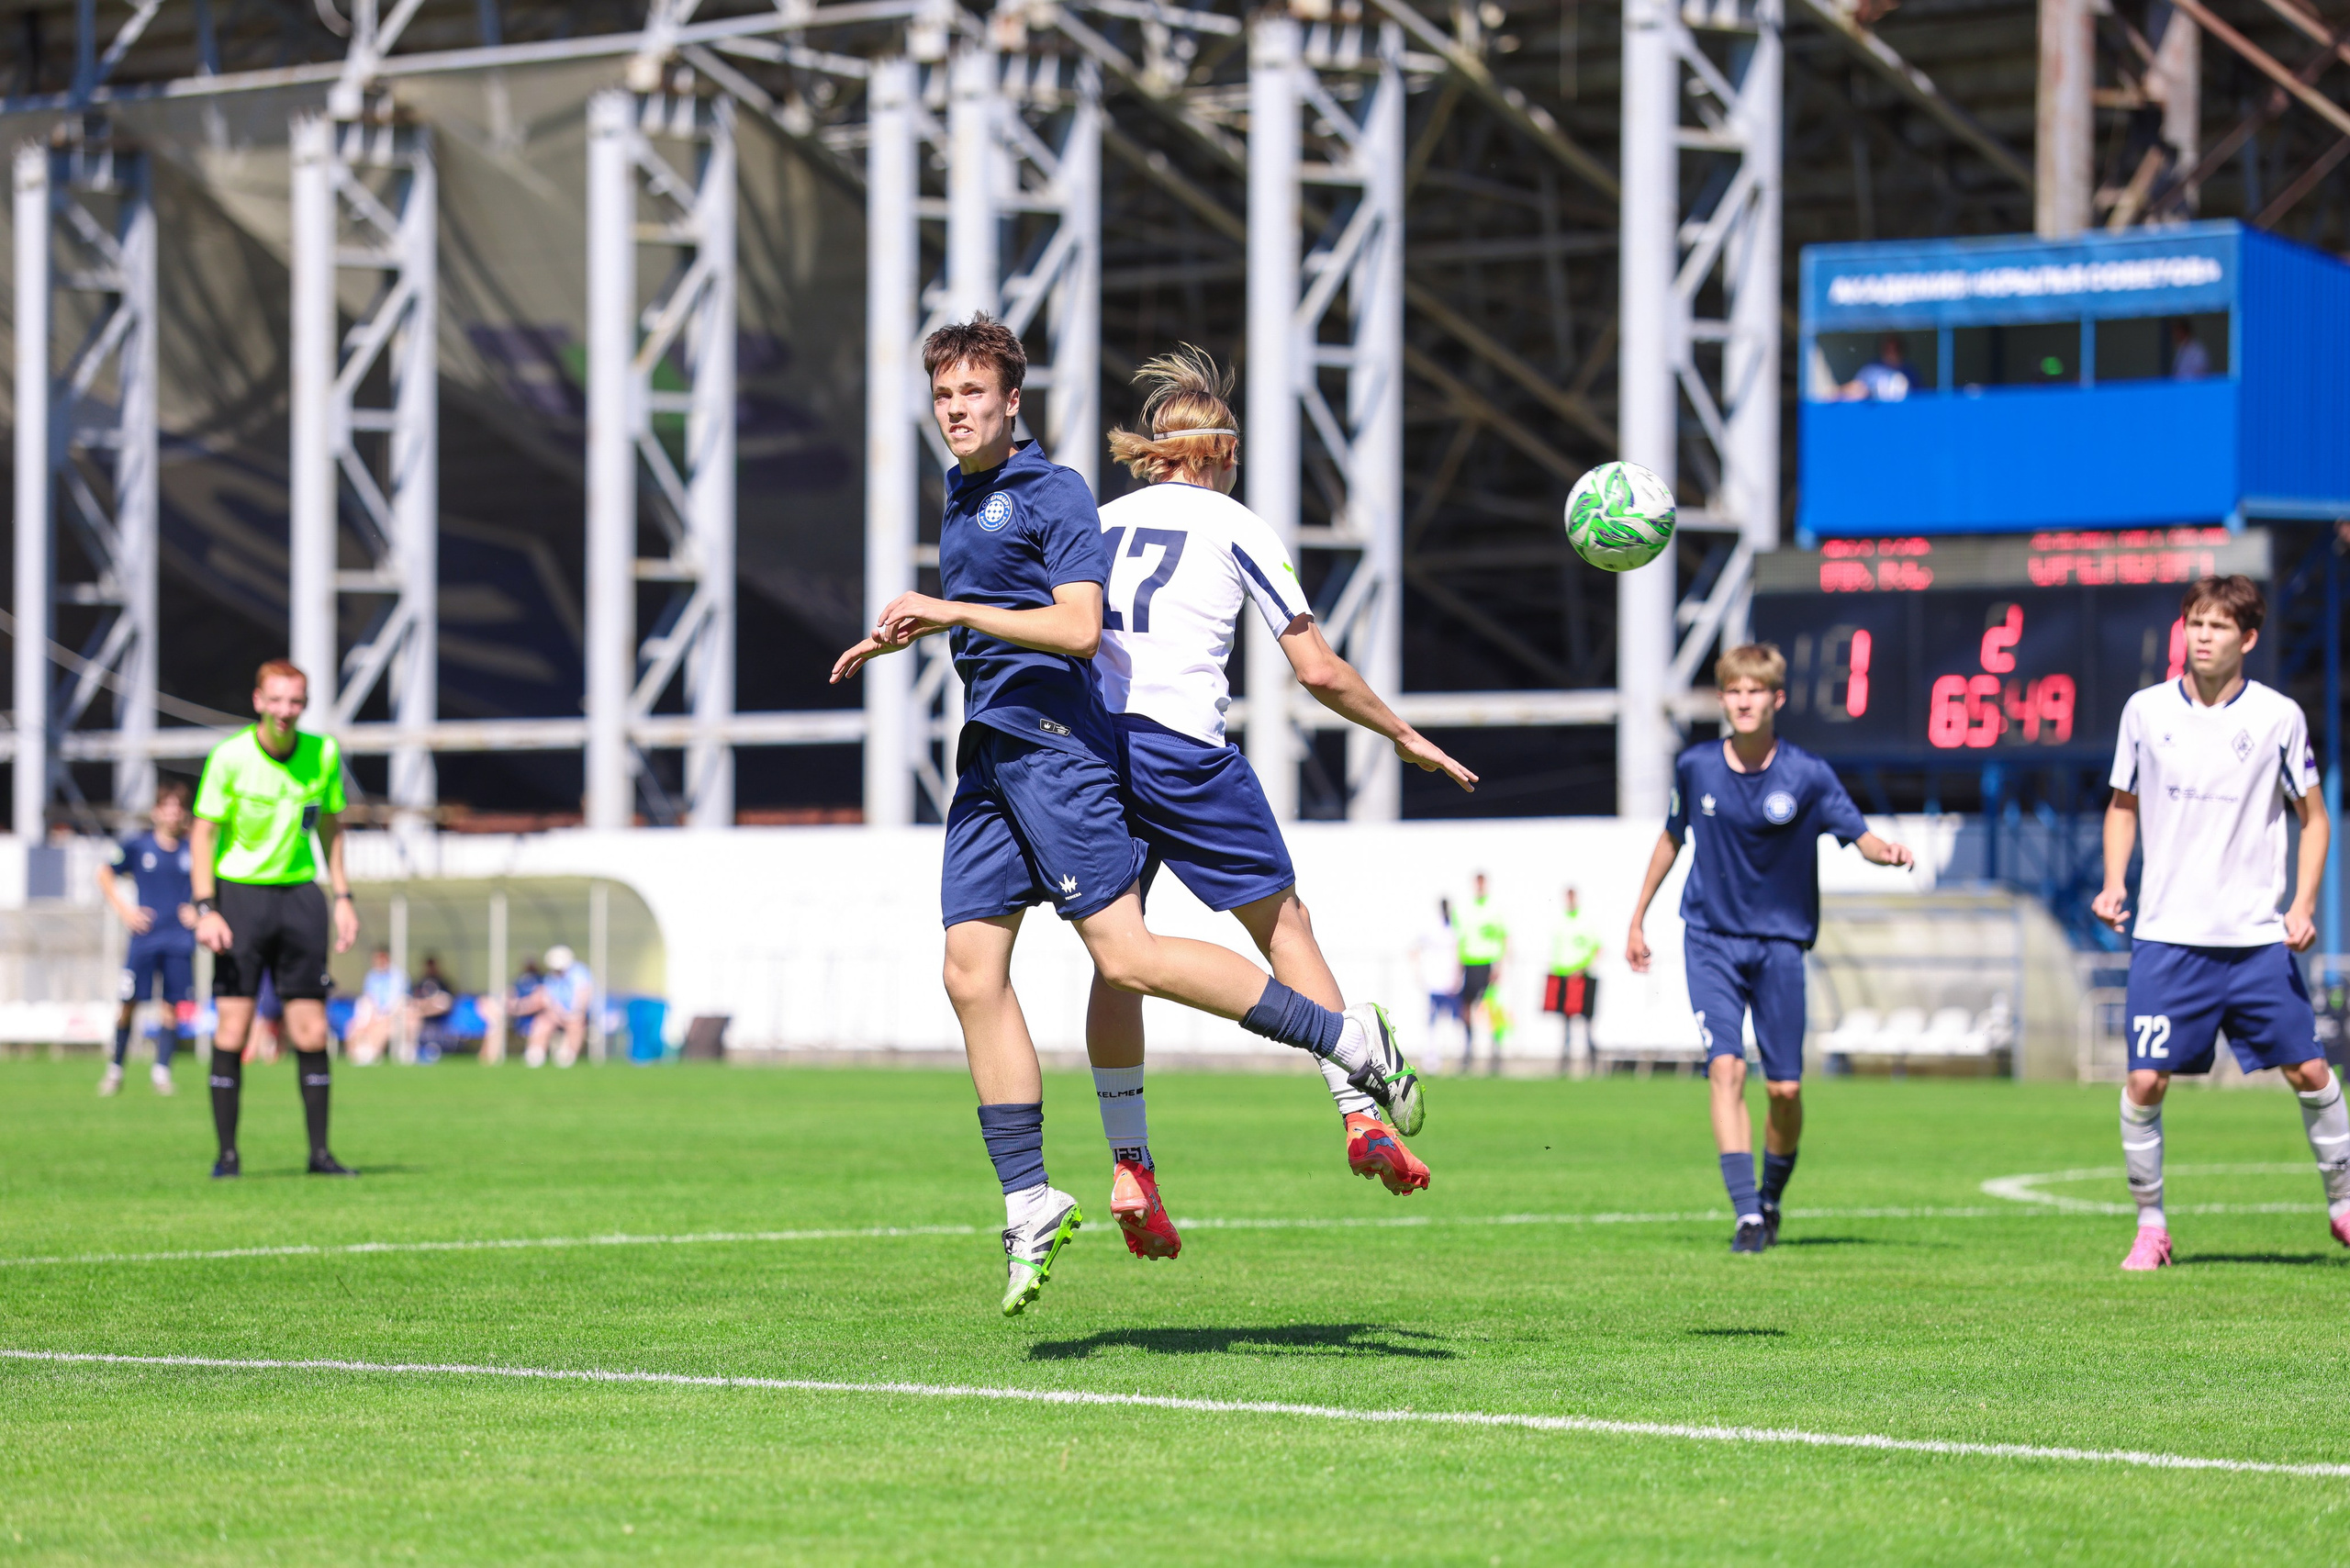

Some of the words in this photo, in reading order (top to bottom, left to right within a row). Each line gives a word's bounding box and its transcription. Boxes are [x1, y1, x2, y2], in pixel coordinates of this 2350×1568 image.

[1102, 526, 1188, 633] 17
[1847, 629, 1872, 717] 1
[1980, 603, 2024, 674] 2
[2133, 1014, 2171, 1058] 72
[1097, 1089, 1136, 1099] KELME
